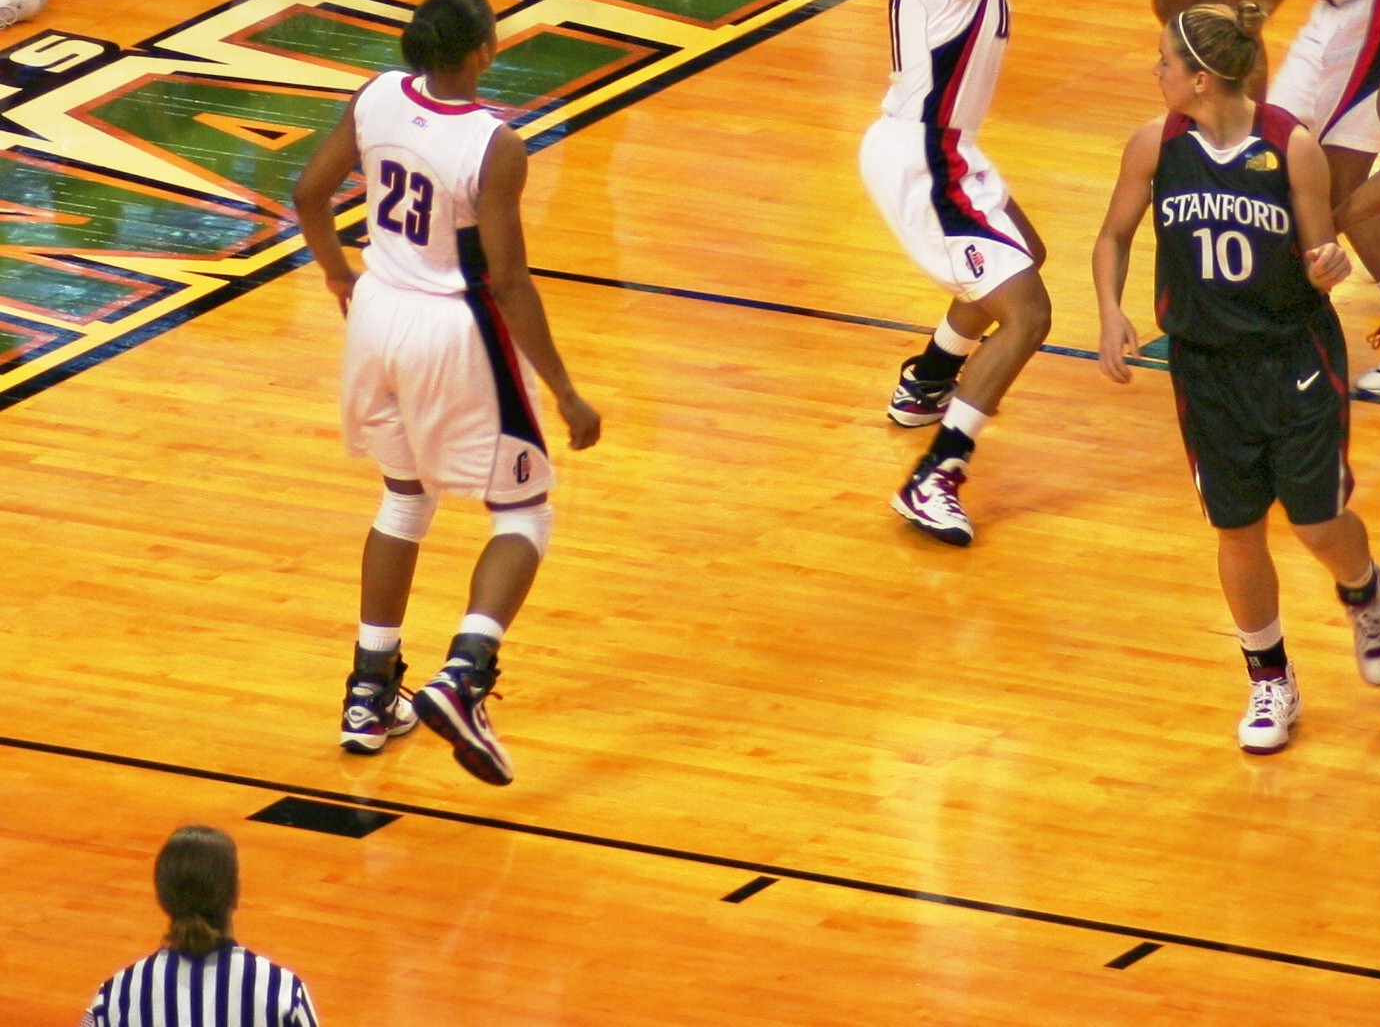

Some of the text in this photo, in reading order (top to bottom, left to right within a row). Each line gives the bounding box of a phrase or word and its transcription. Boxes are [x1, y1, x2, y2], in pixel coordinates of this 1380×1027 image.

[376, 159, 434, 246] 23
[1161, 192, 1290, 235] STANFORD
[1192, 227, 1253, 282] 10
